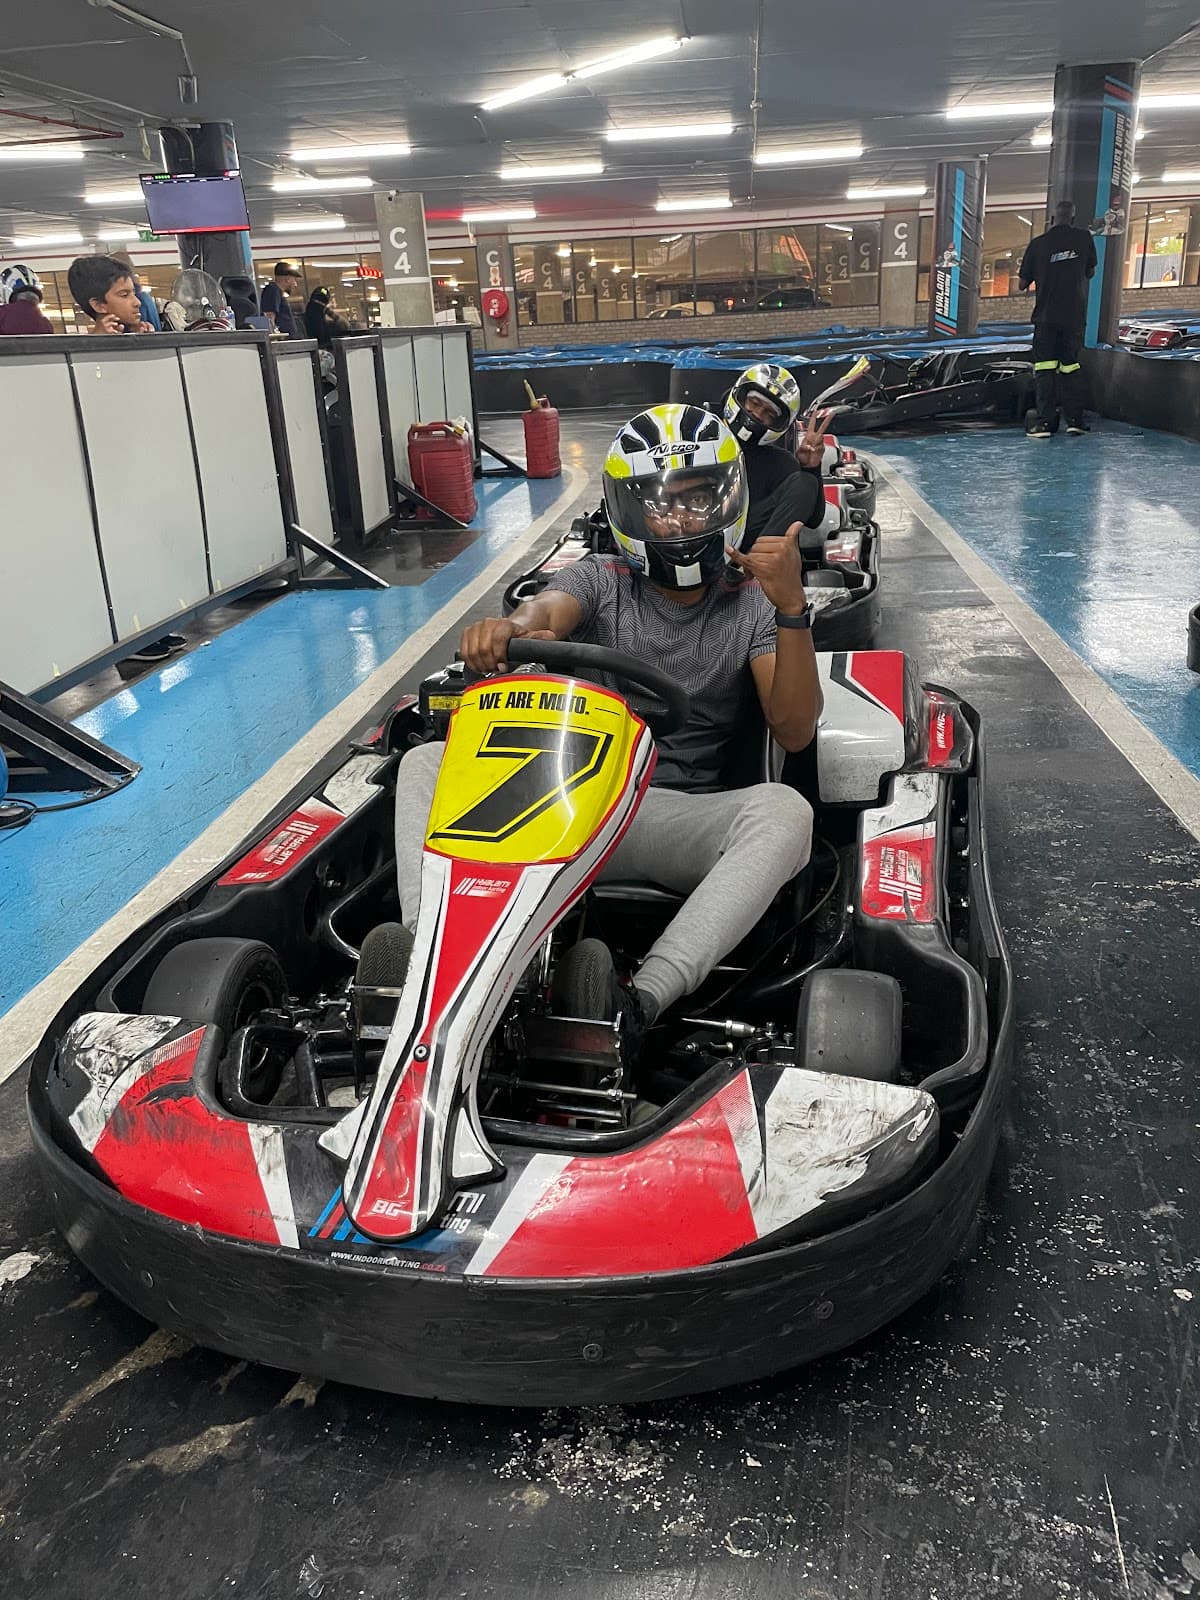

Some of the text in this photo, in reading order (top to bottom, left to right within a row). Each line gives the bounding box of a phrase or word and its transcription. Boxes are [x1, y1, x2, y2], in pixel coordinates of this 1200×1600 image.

[1111, 148, 1124, 187] karting
[389, 227, 408, 249] C
[894, 223, 908, 239] C
[486, 250, 500, 266] C
[860, 243, 871, 256] C
[893, 241, 908, 259] 4
[394, 252, 412, 274] 4
[541, 263, 552, 275] C
[860, 257, 871, 271] 4
[543, 277, 553, 290] 4
[577, 283, 587, 294] 4
[479, 692, 501, 710] WE
[505, 691, 535, 709] ARE
[538, 692, 590, 715] MOTO.
[429, 721, 614, 843] 7
[372, 1199, 405, 1217] BG
